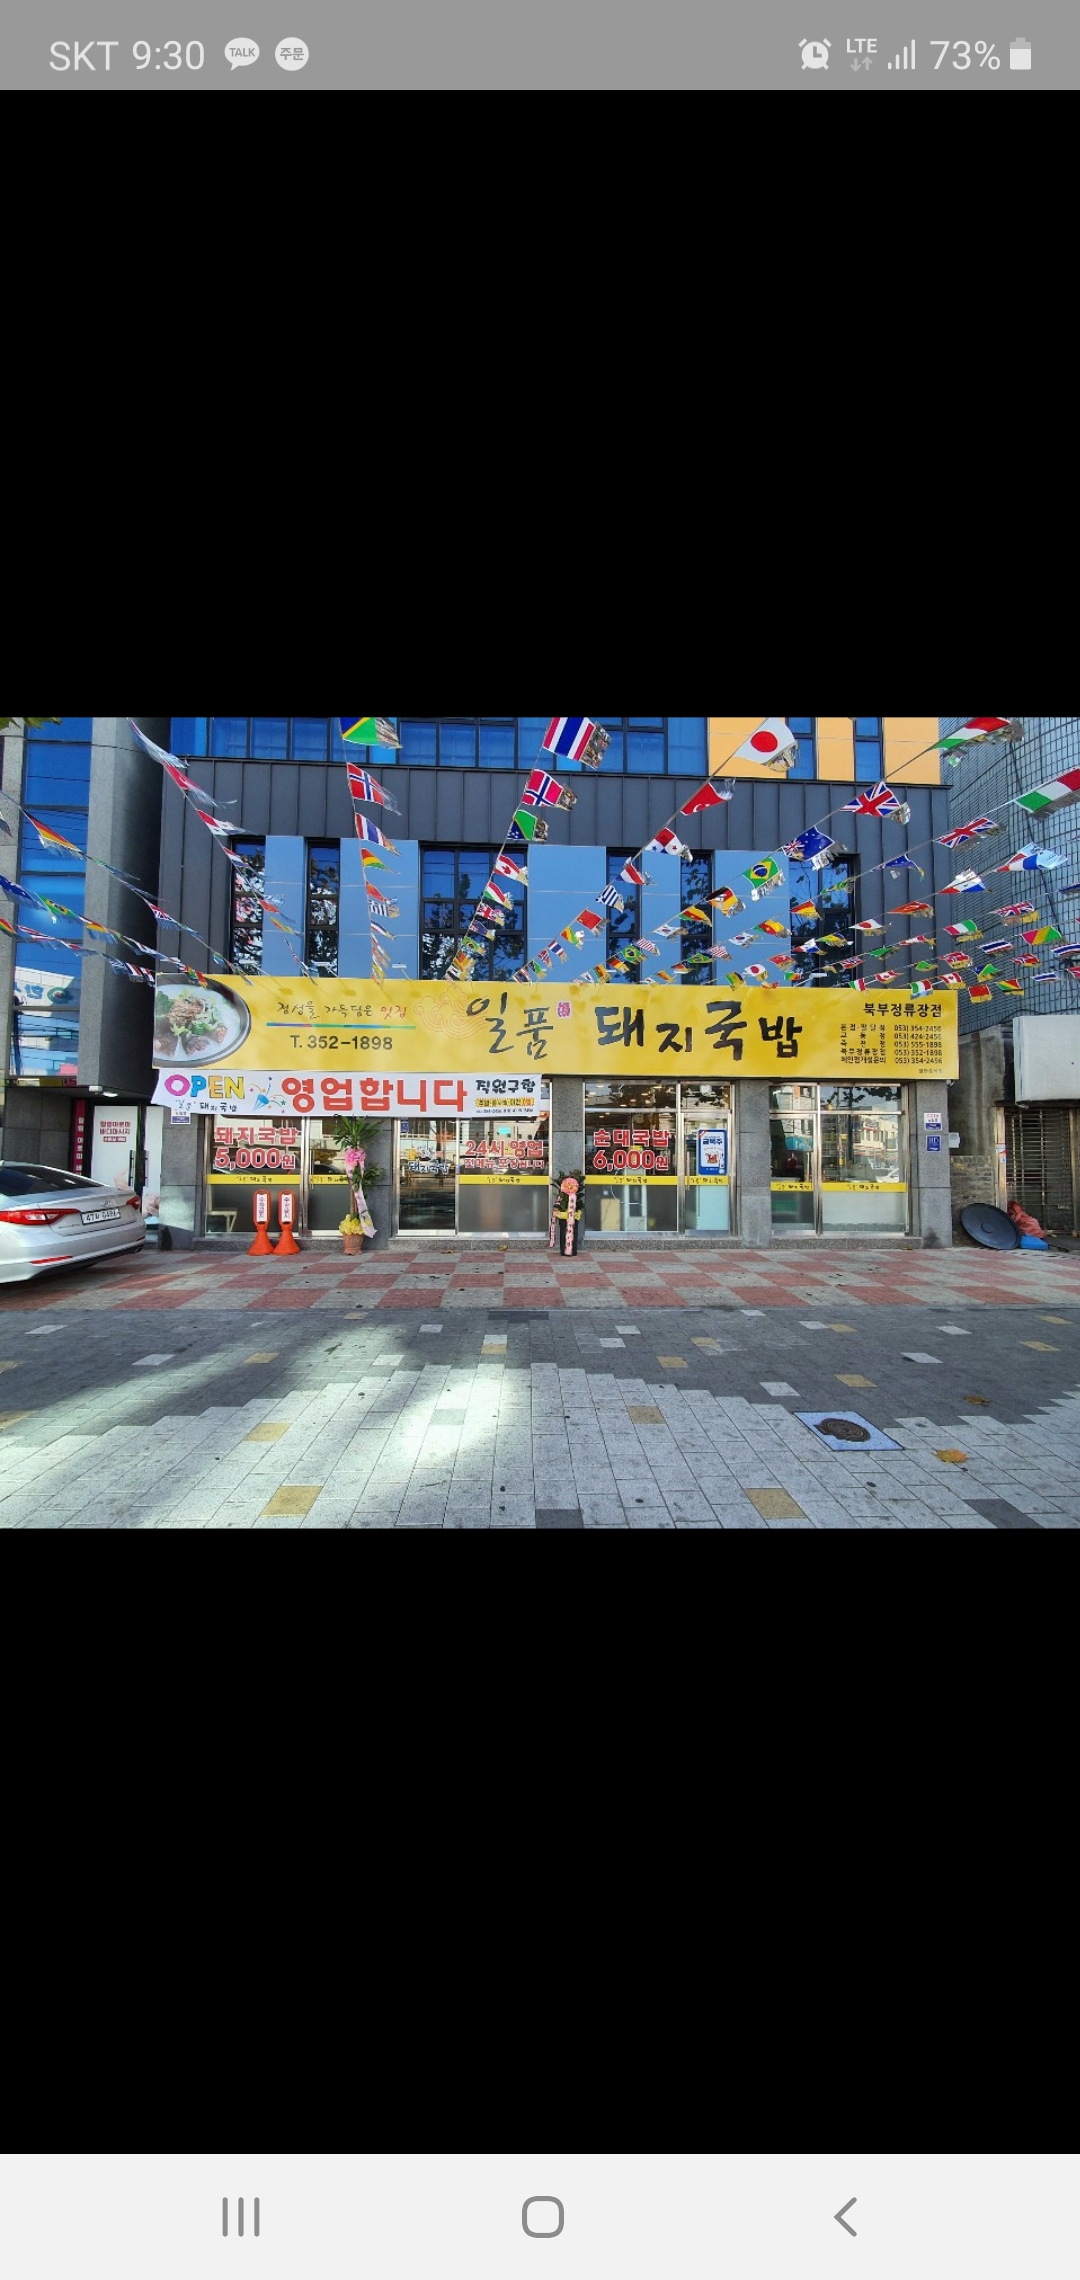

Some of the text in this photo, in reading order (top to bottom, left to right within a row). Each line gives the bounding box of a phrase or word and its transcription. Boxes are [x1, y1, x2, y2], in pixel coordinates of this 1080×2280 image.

[863, 1002, 941, 1018] 북부정류장점
[466, 991, 554, 1061] 일품
[594, 1000, 803, 1062] 돼지국밥
[290, 1034, 393, 1050] T. 352-1898
[164, 1073, 246, 1100] OPEN
[281, 1076, 468, 1114] 영업합니다
[475, 1078, 536, 1095] 직원구함
[214, 1126, 299, 1146] 돼지국밥
[593, 1128, 670, 1147] 순대국밥
[214, 1147, 296, 1170] 5,000원
[464, 1139, 544, 1158] 24시 영업
[593, 1149, 669, 1172] 6,000원
